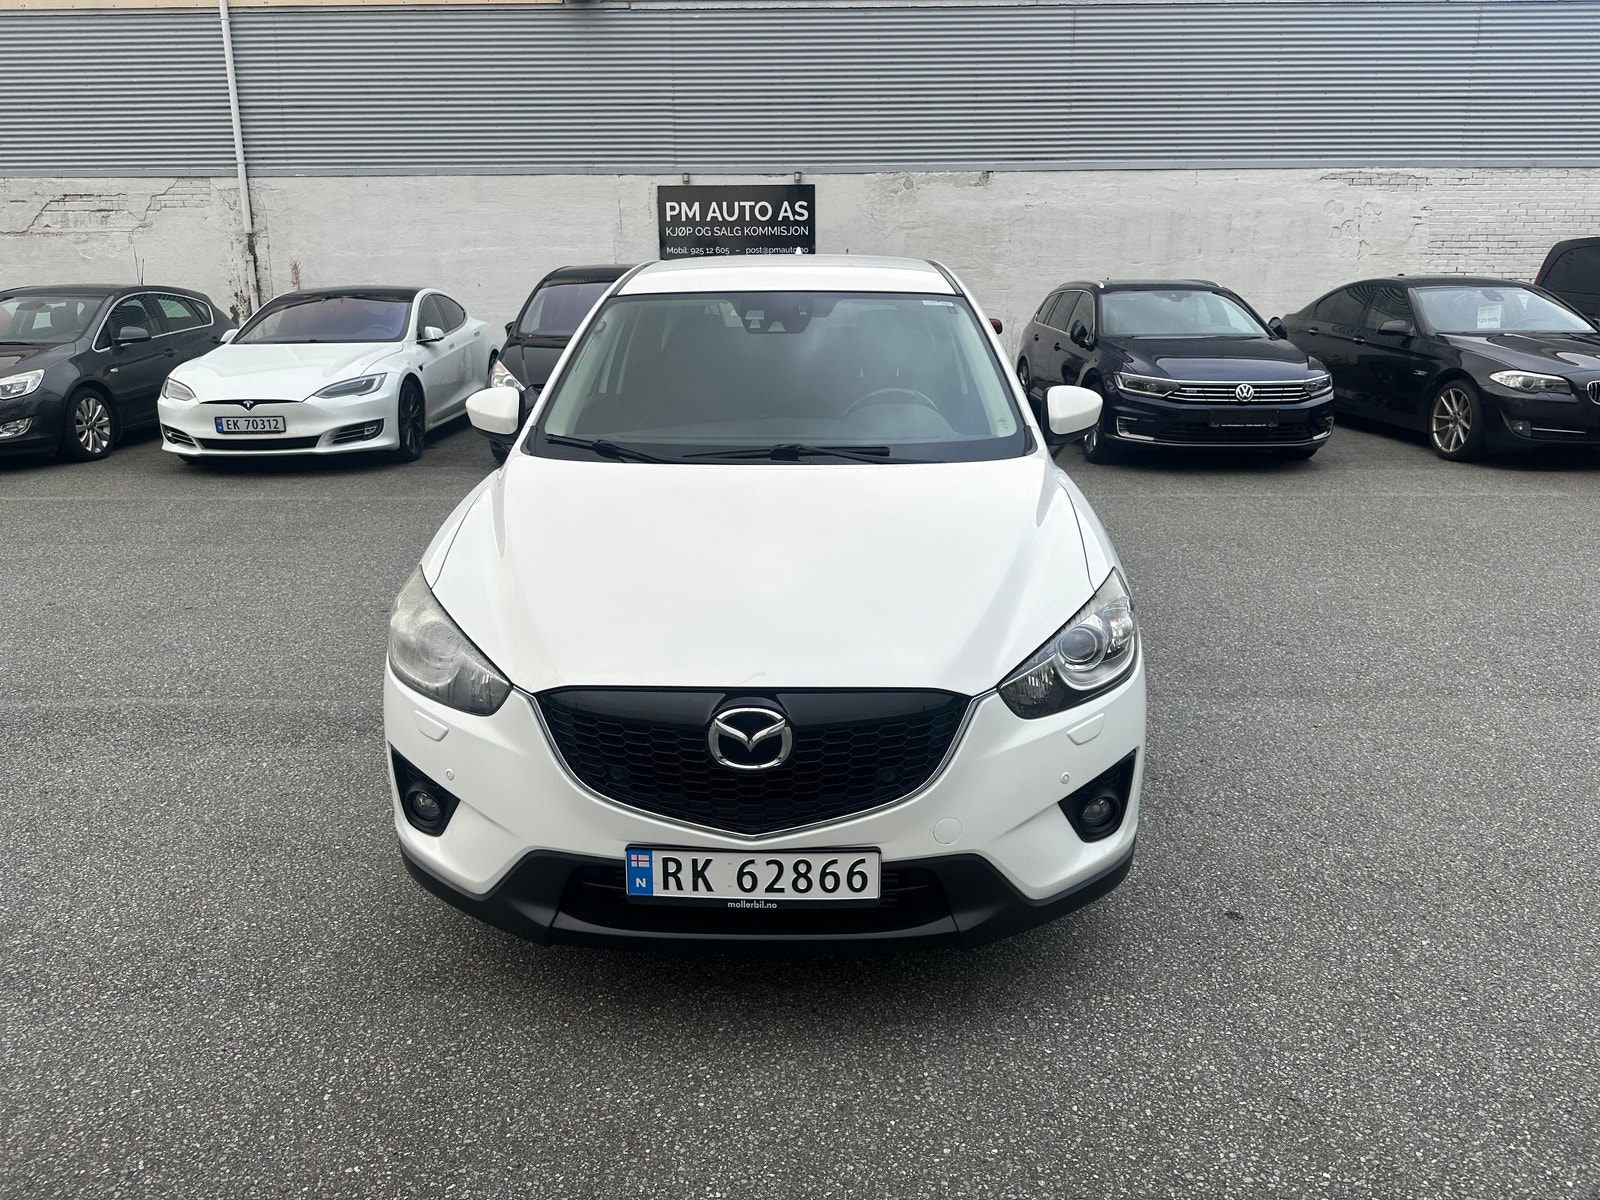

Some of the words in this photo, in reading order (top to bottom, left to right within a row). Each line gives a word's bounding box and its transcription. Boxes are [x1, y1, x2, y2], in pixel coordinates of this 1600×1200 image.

[666, 202, 700, 222] PM
[706, 201, 773, 222] AUTO
[778, 201, 809, 221] AS
[666, 226, 693, 237] KJØP
[695, 226, 712, 236] OG
[714, 226, 741, 236] SALG
[744, 226, 809, 236] KOMMISJON
[690, 247, 705, 255] 925
[715, 246, 730, 255] 605
[226, 419, 240, 430] EK
[244, 419, 279, 430] 70312
[661, 856, 715, 892] RK
[736, 857, 869, 894] 62866
[635, 877, 647, 888] N
[727, 900, 778, 909] mollerbil.no
